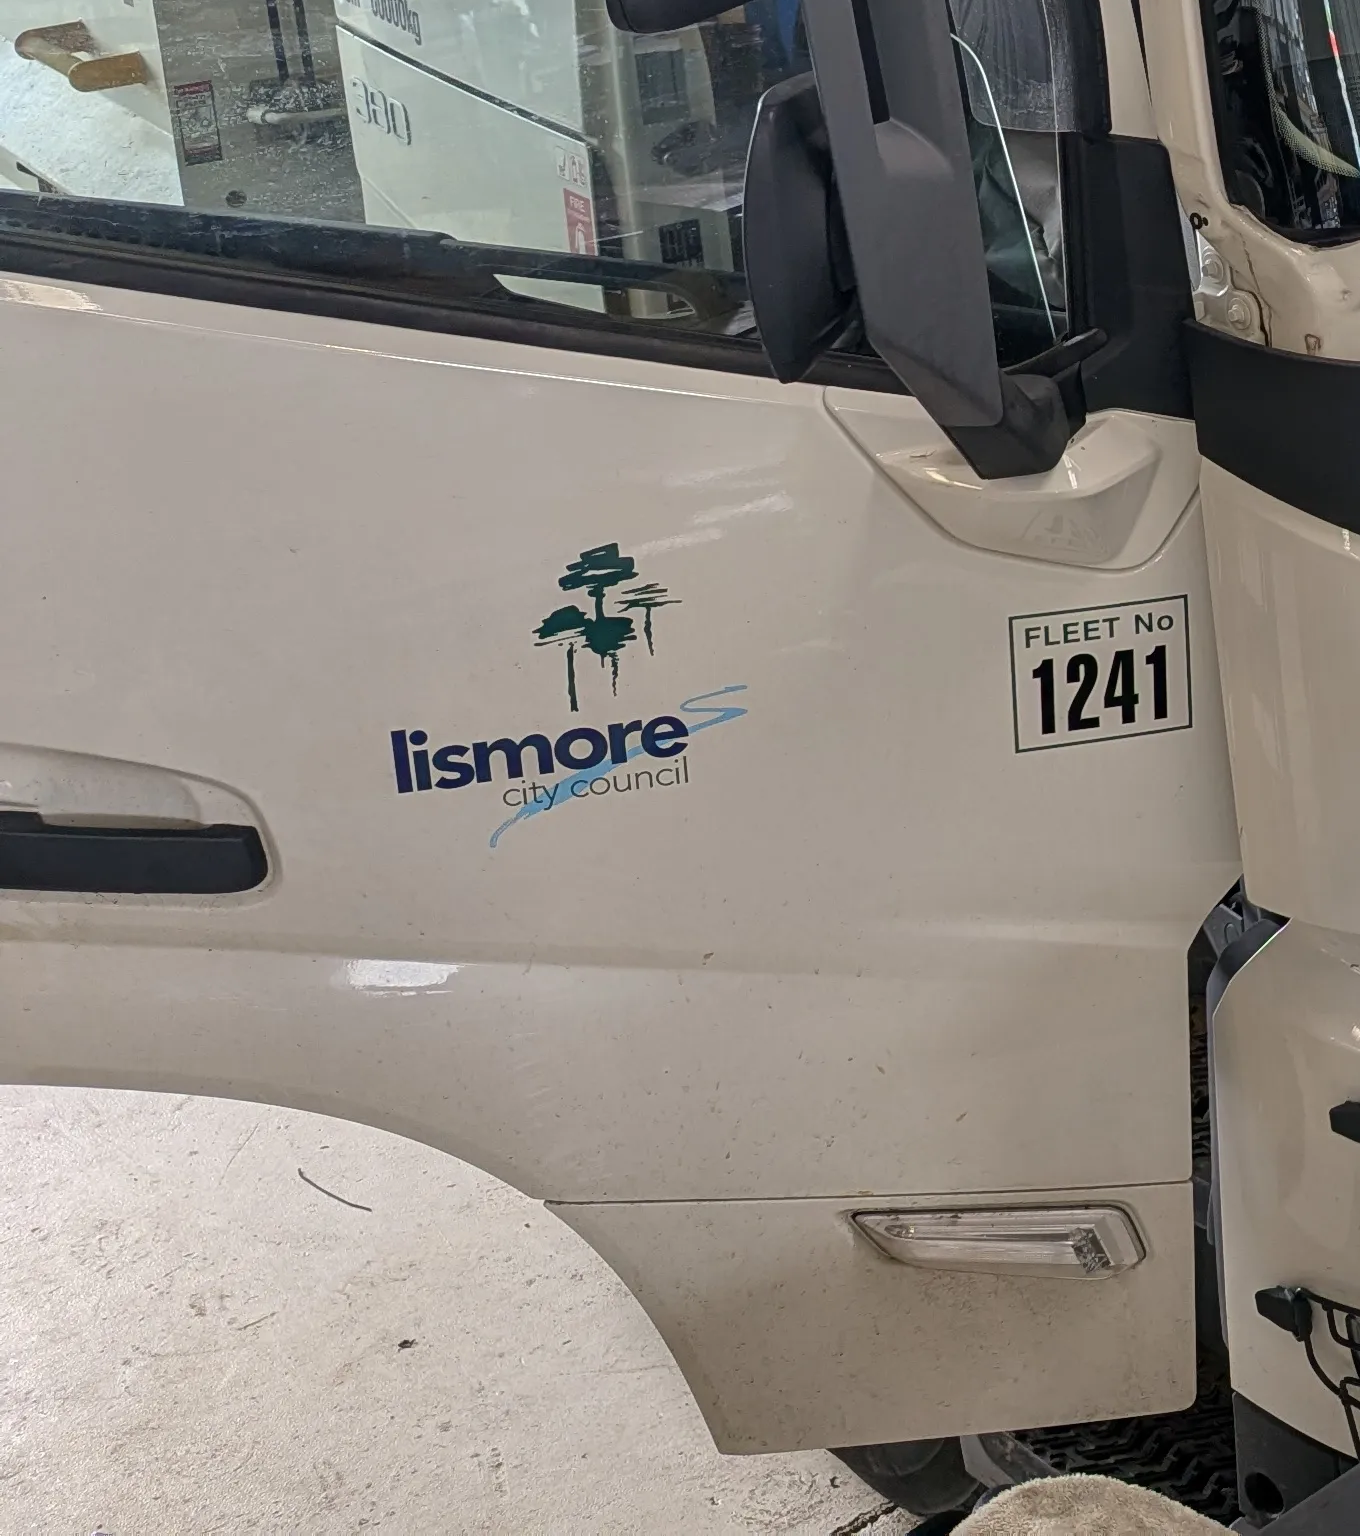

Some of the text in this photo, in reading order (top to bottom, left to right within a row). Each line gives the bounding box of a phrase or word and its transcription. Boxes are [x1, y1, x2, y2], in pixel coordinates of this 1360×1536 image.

[1023, 611, 1175, 649] FLEET No
[1031, 645, 1170, 735] 1241
[390, 714, 691, 794] lismore
[501, 756, 690, 811] city council
